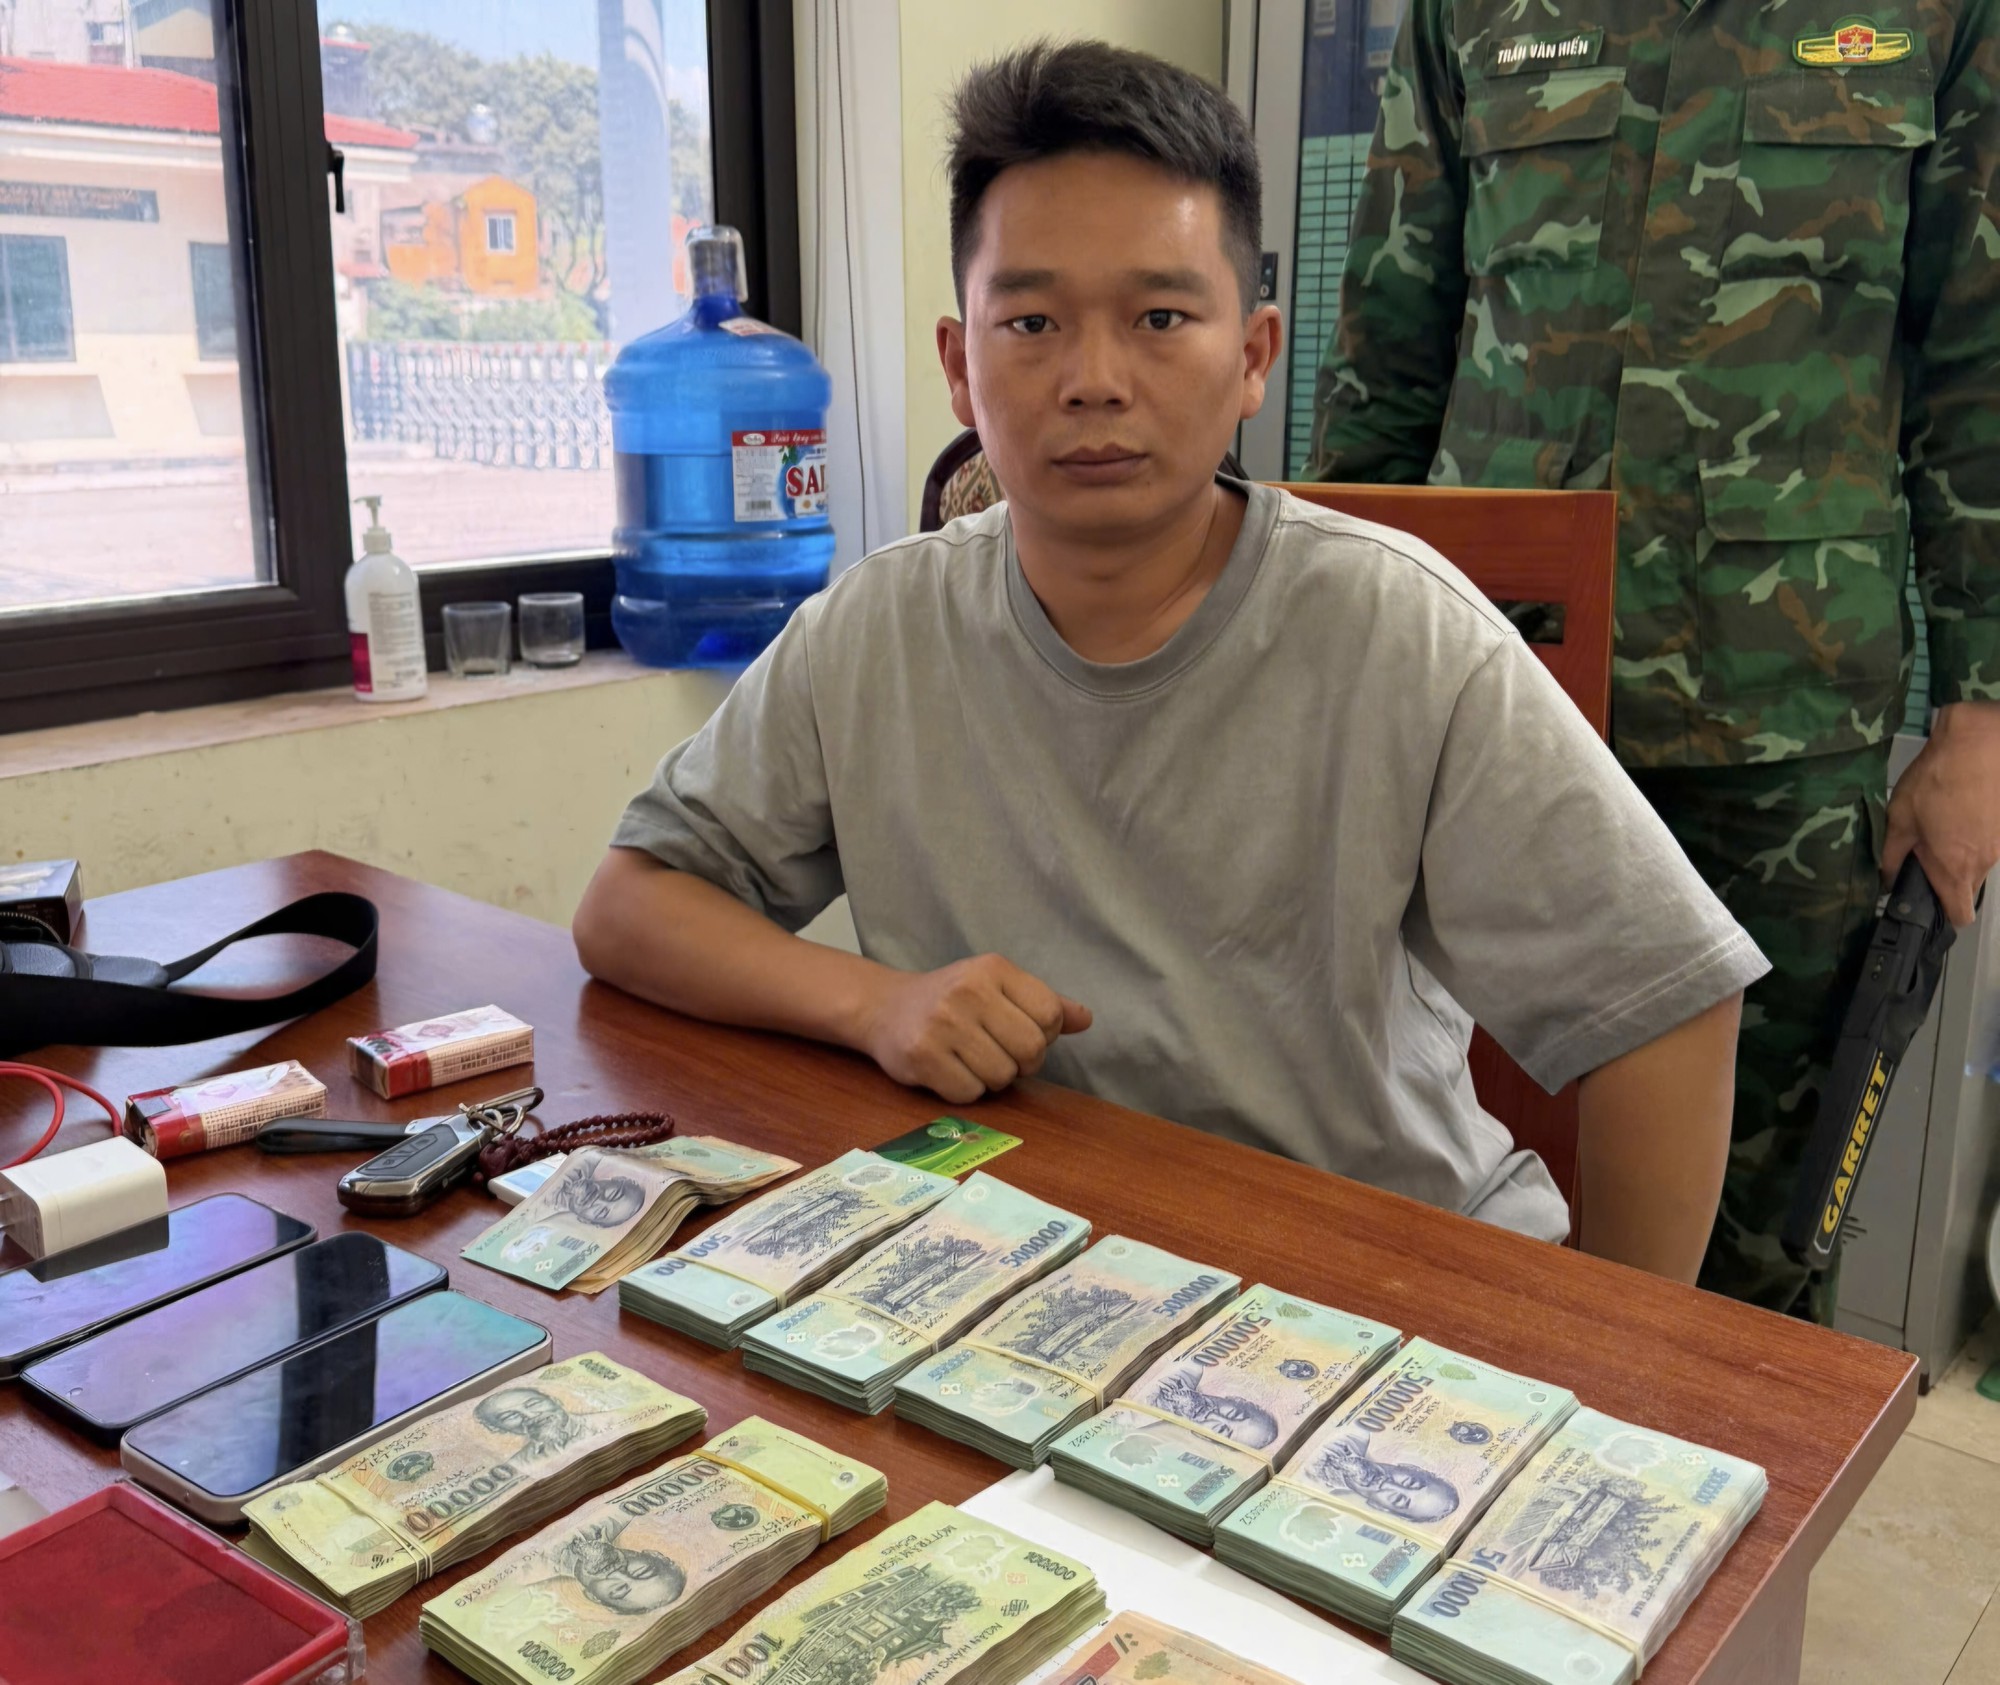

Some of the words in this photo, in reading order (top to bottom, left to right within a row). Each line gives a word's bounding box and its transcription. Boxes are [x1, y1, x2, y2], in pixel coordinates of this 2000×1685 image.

[1823, 1051, 1886, 1233] GARRET
[1192, 1313, 1271, 1366] 500000
[1356, 1371, 1435, 1432] 500000
